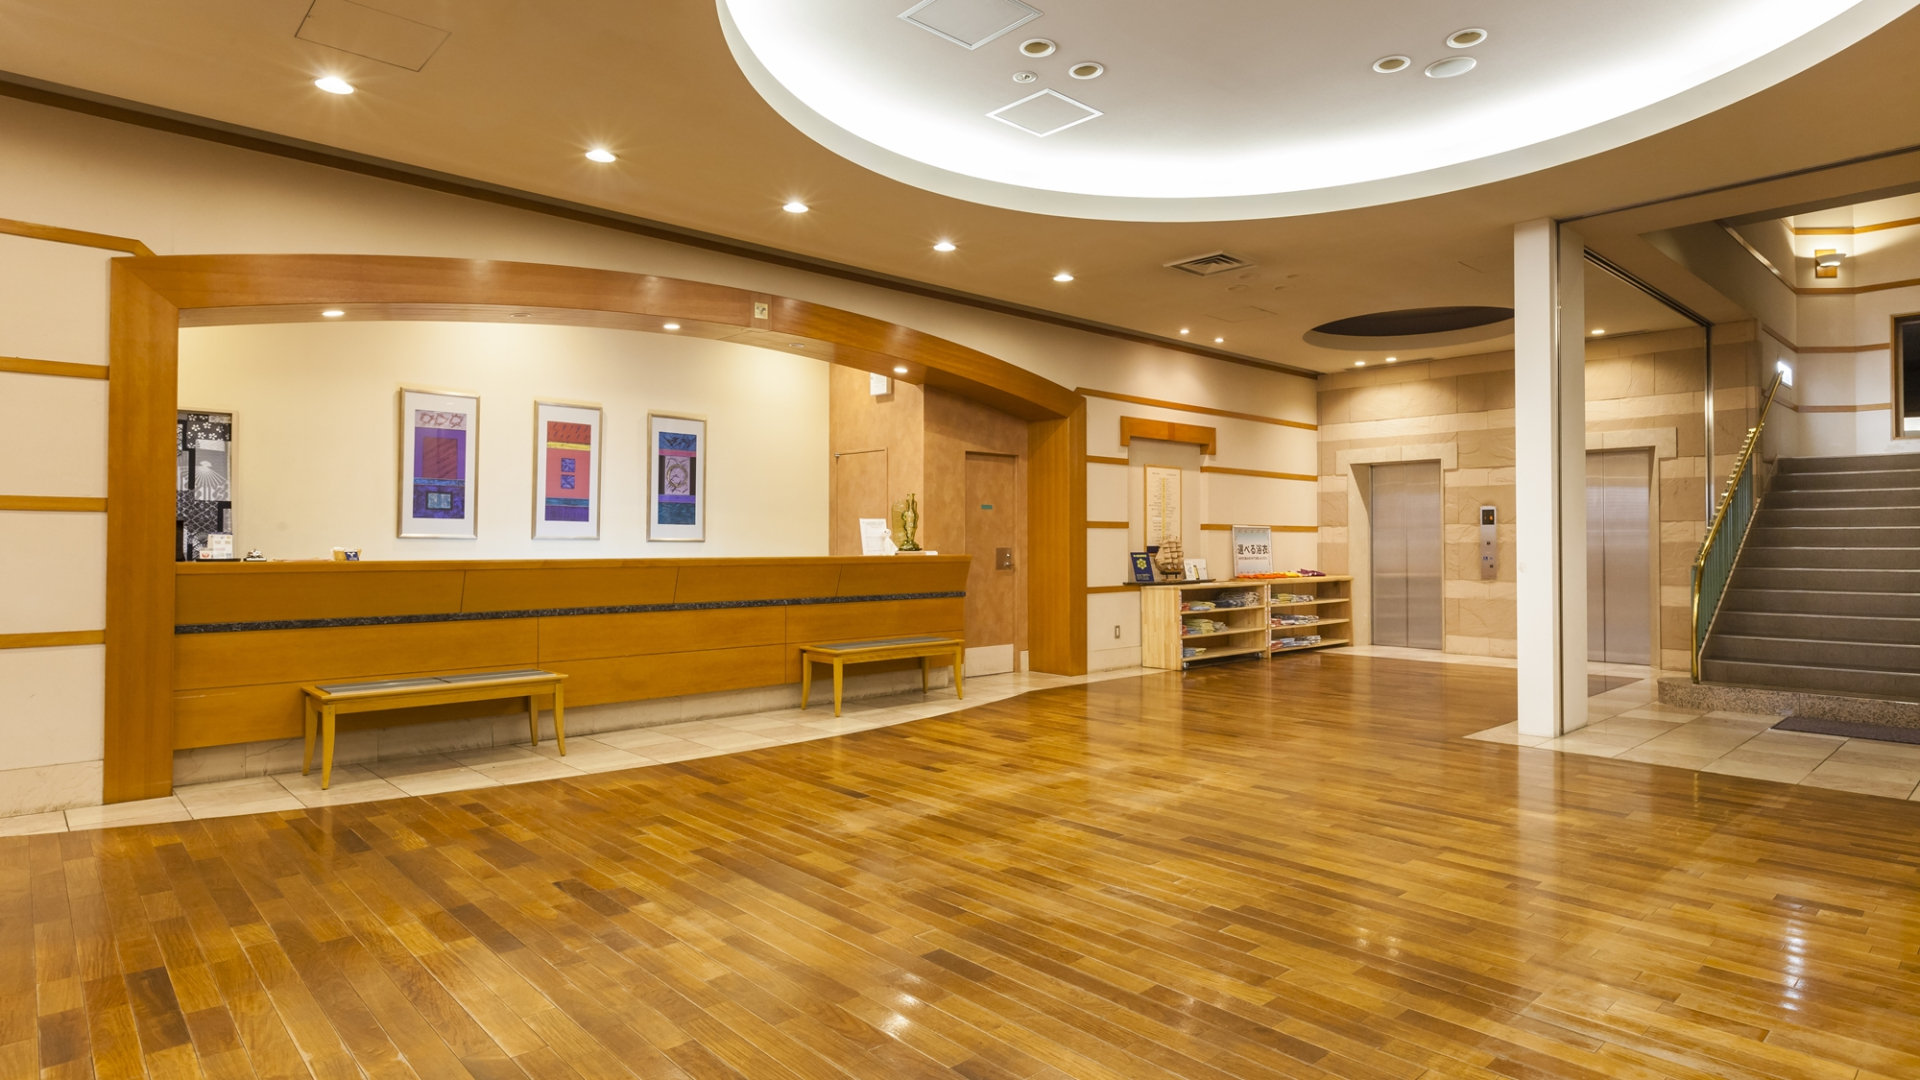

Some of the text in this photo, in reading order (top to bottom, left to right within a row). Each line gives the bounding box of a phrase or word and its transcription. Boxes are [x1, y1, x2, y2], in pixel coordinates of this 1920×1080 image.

[1237, 543, 1269, 555] 選べる浴衣
